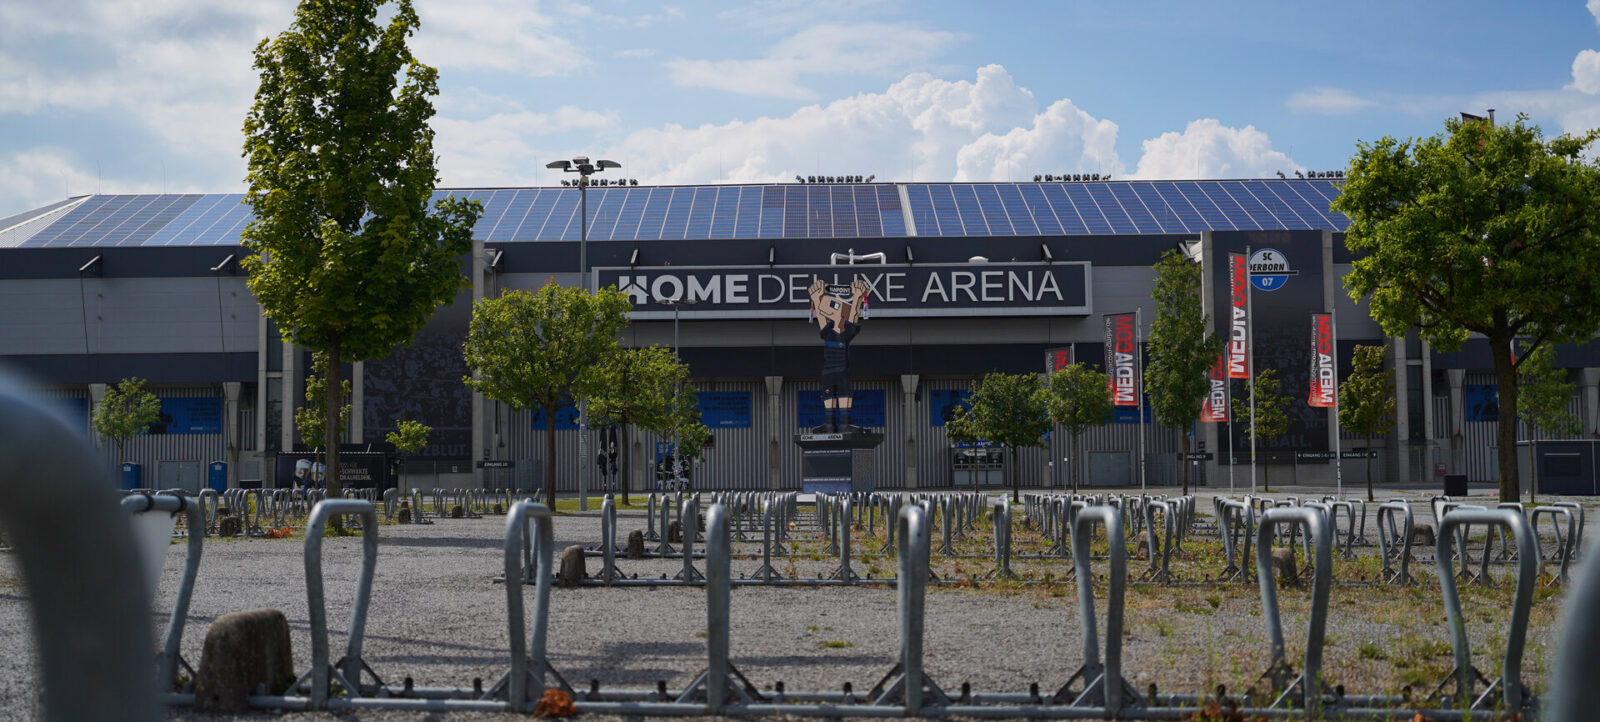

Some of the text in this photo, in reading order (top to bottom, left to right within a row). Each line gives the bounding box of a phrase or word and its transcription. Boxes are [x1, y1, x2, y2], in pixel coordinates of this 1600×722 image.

[1263, 252, 1272, 261] SC
[1249, 263, 1285, 271] DERBORN
[1262, 277, 1273, 286] 07
[619, 274, 749, 304] HOME
[921, 270, 1065, 303] ARENA
